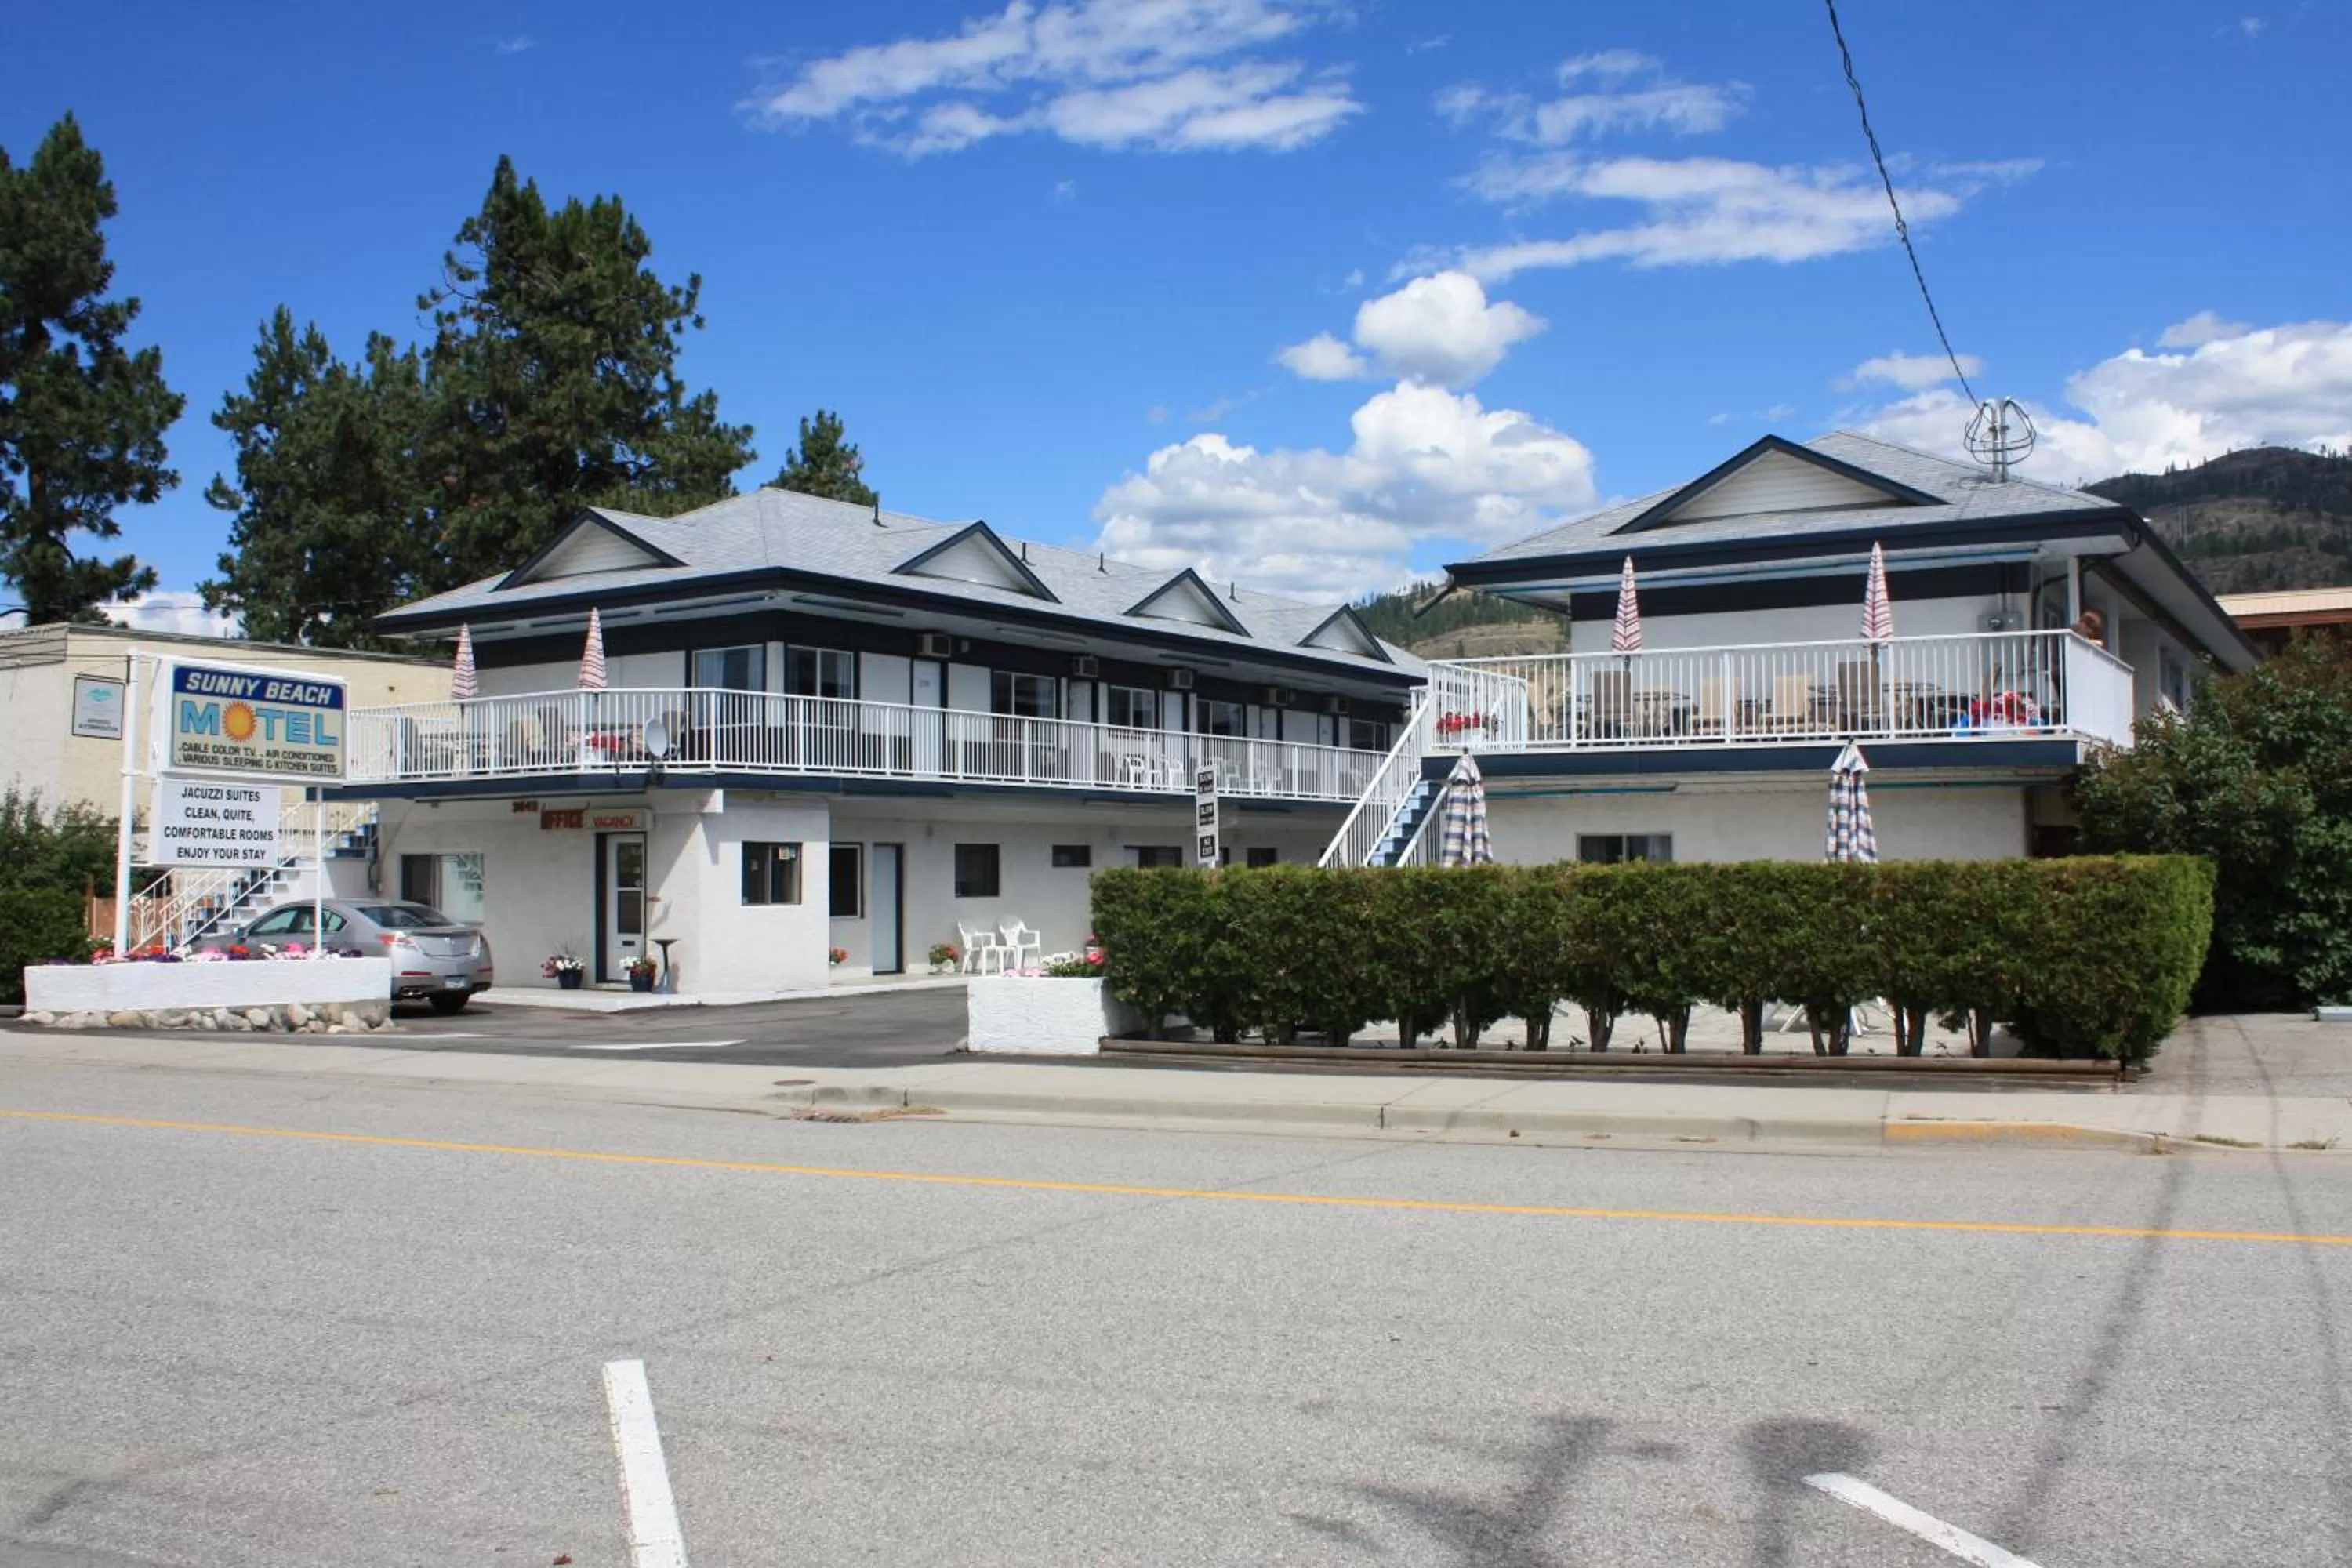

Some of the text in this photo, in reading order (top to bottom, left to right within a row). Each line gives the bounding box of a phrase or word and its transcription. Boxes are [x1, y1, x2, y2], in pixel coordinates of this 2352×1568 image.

[186, 672, 333, 706] SUNNY BEACH
[282, 750, 336, 763] CONDITIONED
[274, 760, 308, 771] KITCHEN
[181, 786, 261, 802] JACUZZI SUITES
[185, 806, 256, 825] CLEAN, QUITE,
[164, 826, 274, 841] COMFORTABLE ROOMS
[177, 846, 267, 860] ENJOY YOUR STAY
